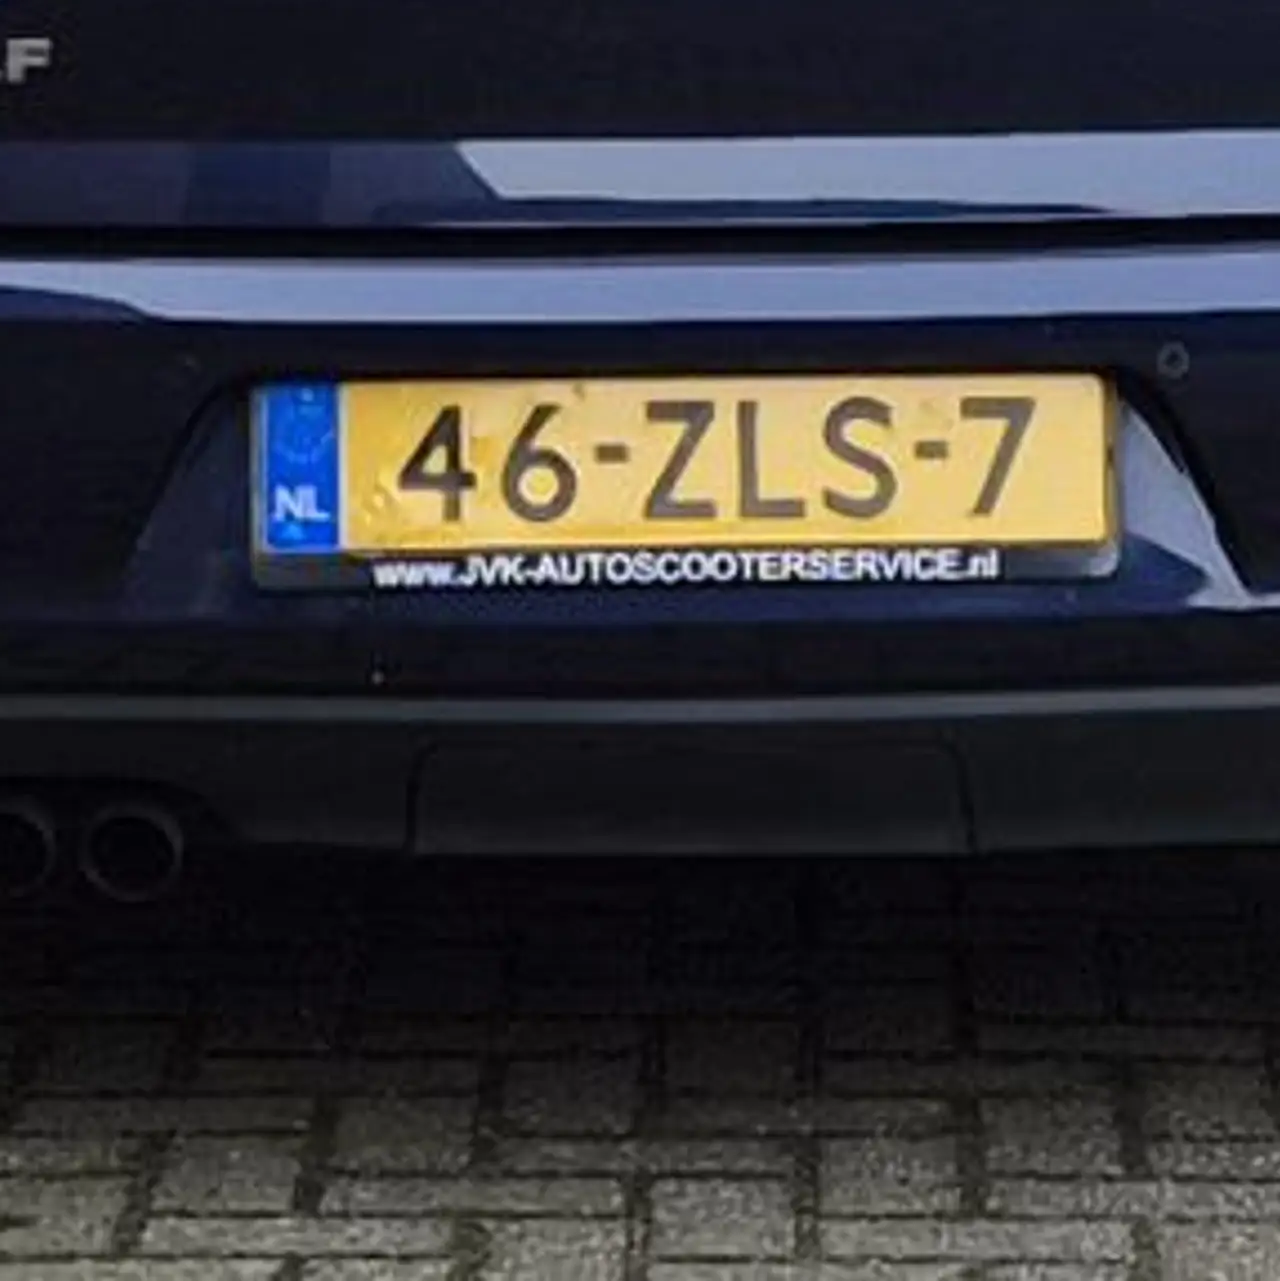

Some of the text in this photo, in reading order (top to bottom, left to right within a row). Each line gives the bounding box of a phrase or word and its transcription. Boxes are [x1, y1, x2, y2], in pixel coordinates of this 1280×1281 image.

[397, 396, 1038, 523] 46-ZLS-7
[274, 484, 331, 522] NL
[372, 547, 1001, 588] www.JVK-AUTOSCOOTERSERVICE.nl
